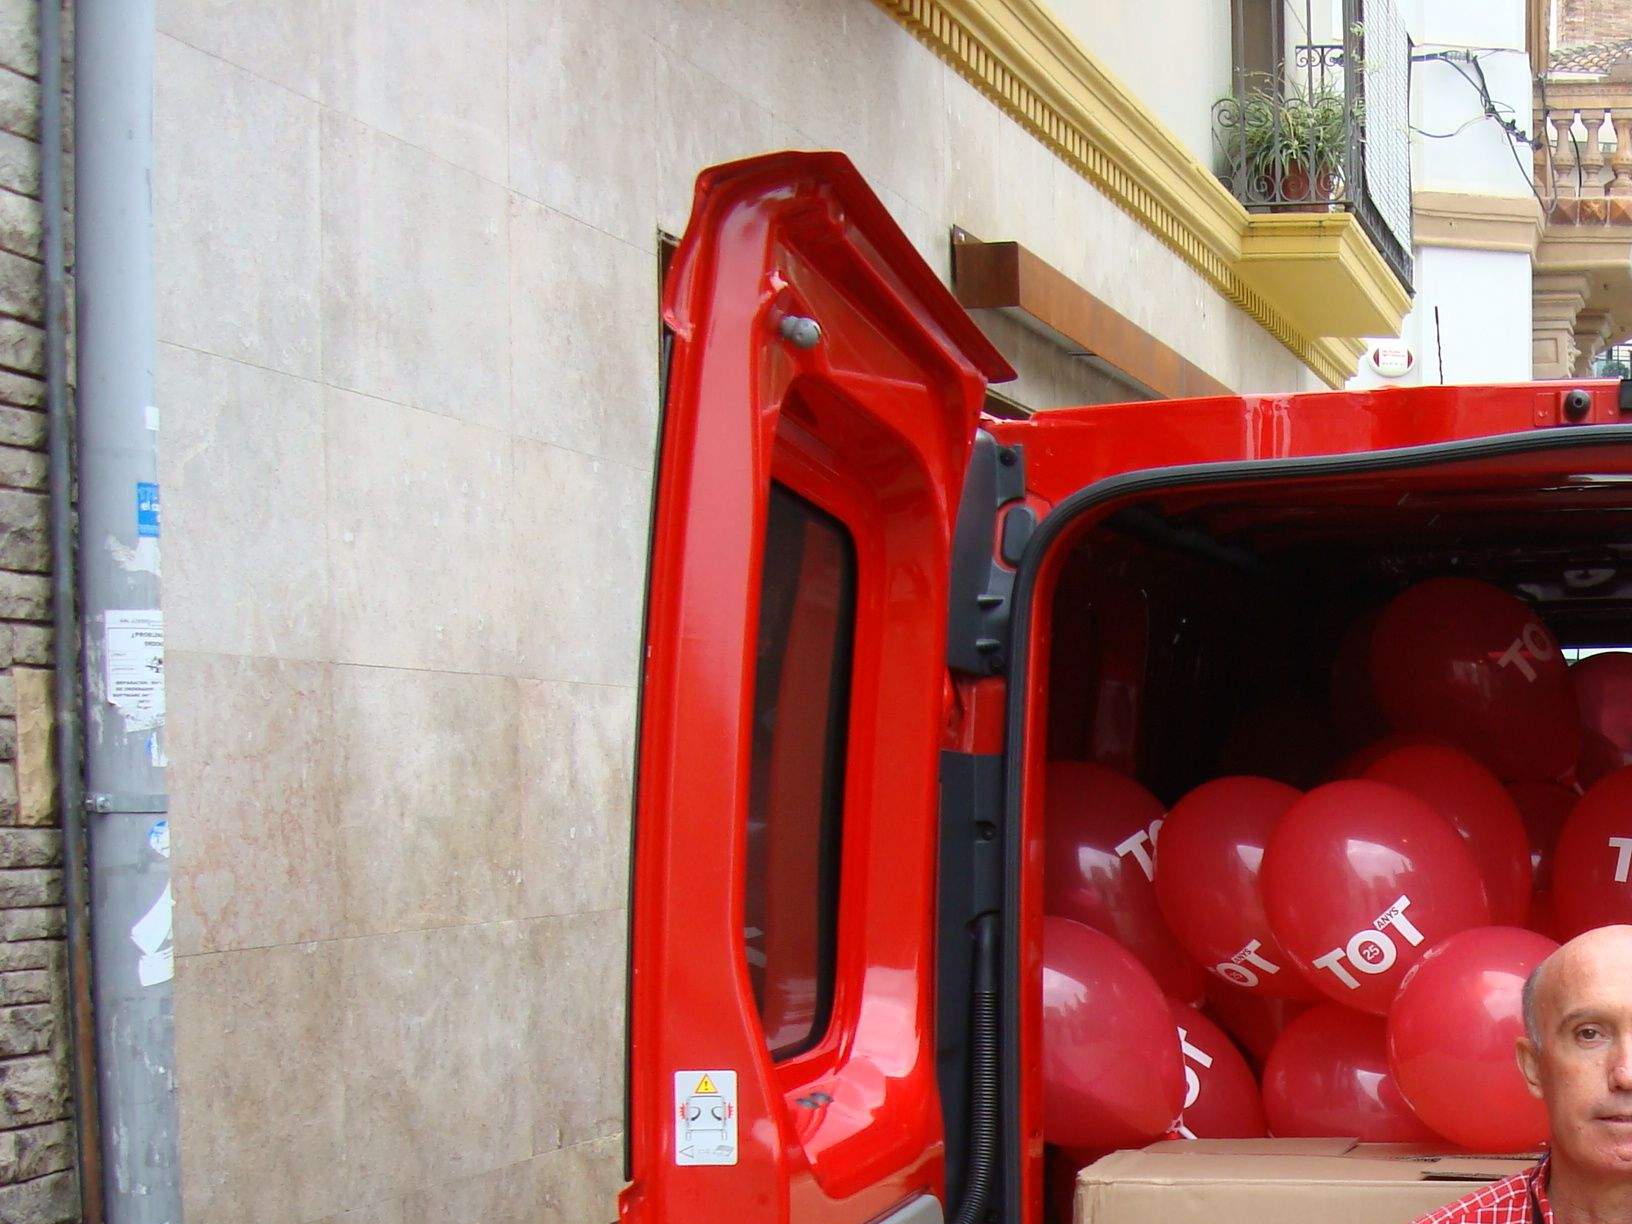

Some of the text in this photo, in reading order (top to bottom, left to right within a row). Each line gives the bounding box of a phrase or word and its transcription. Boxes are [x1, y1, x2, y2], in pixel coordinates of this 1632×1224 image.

[1497, 622, 1553, 683] TO
[1376, 906, 1399, 928] ANYS
[1206, 939, 1280, 988] OT
[1312, 894, 1425, 990] TOT
[1362, 944, 1380, 961] 25
